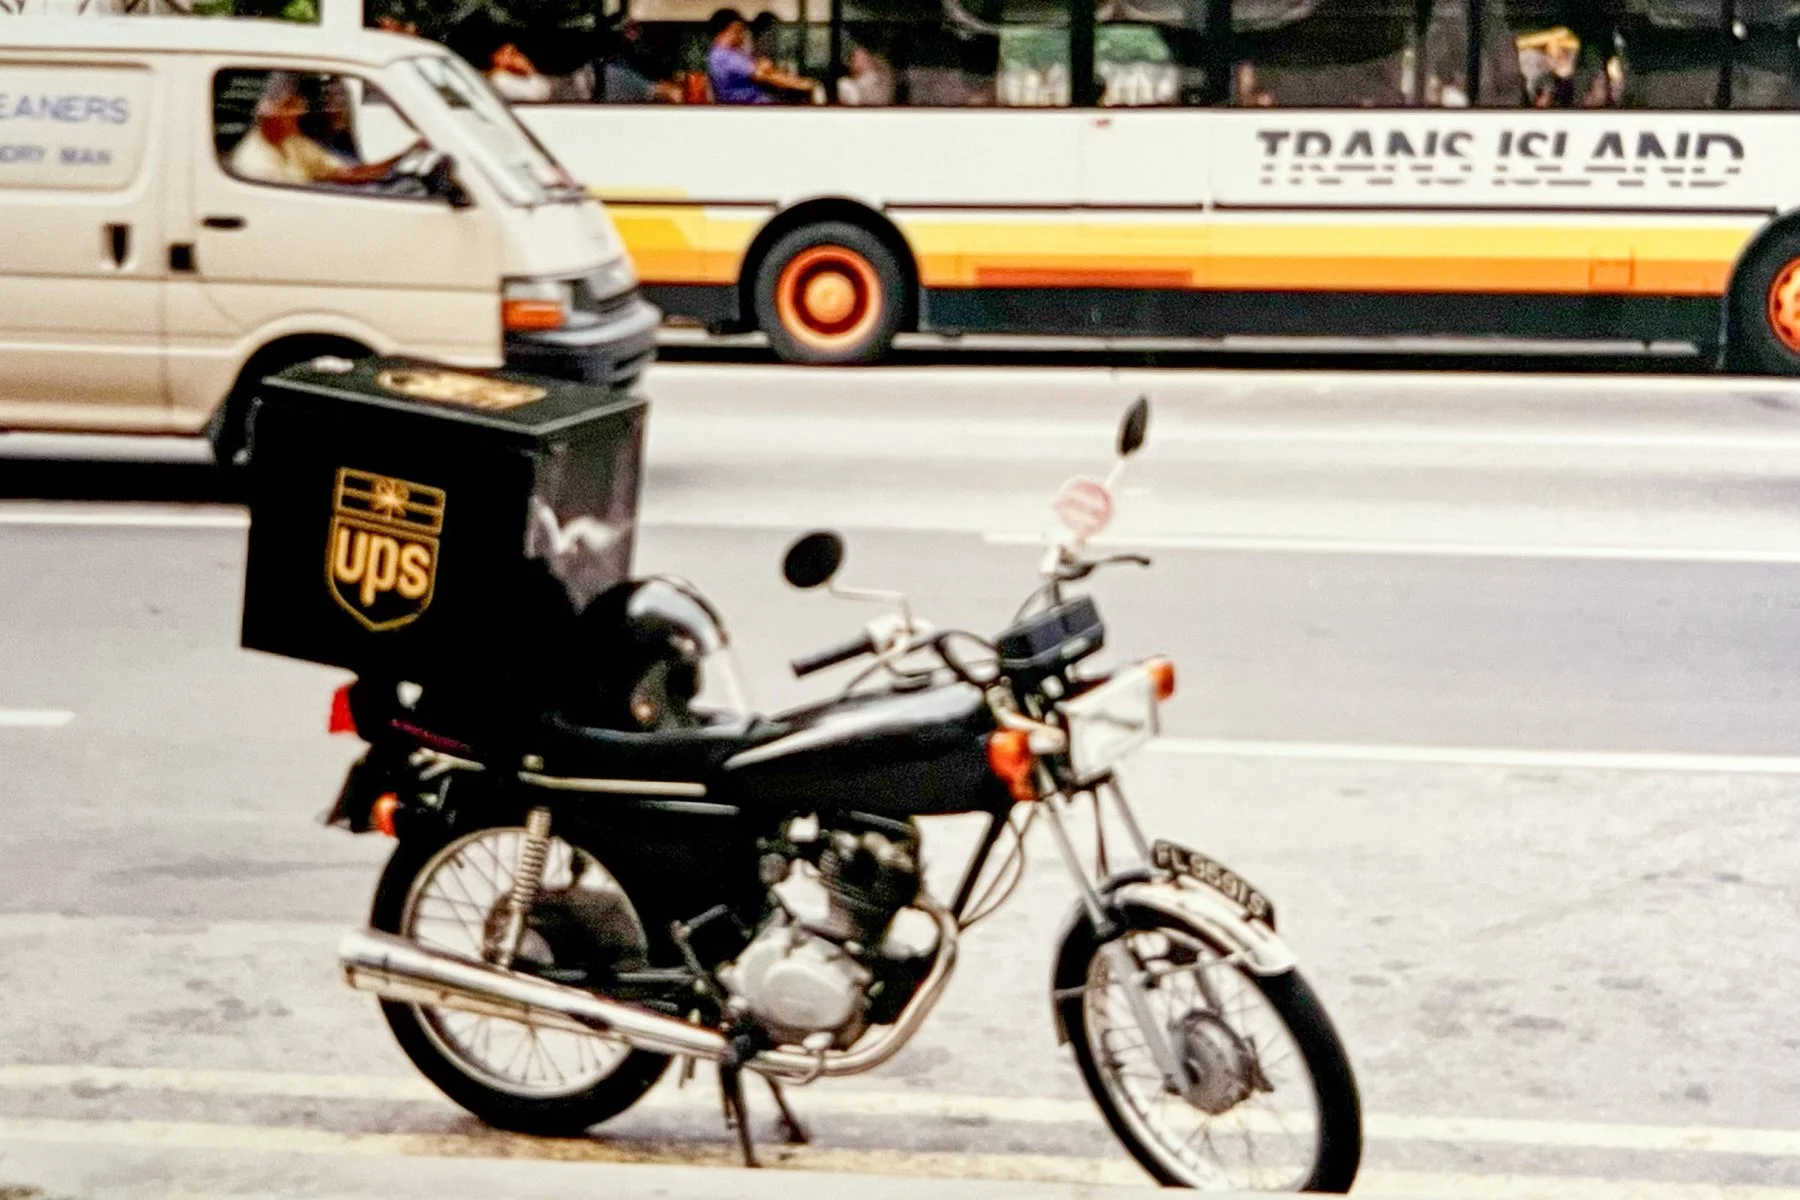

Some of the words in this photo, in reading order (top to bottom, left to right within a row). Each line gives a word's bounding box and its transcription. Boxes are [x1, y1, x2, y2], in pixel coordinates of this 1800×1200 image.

[1256, 129, 1473, 187] TRANS
[1491, 129, 1745, 188] ISLAND
[334, 528, 431, 607] ups
